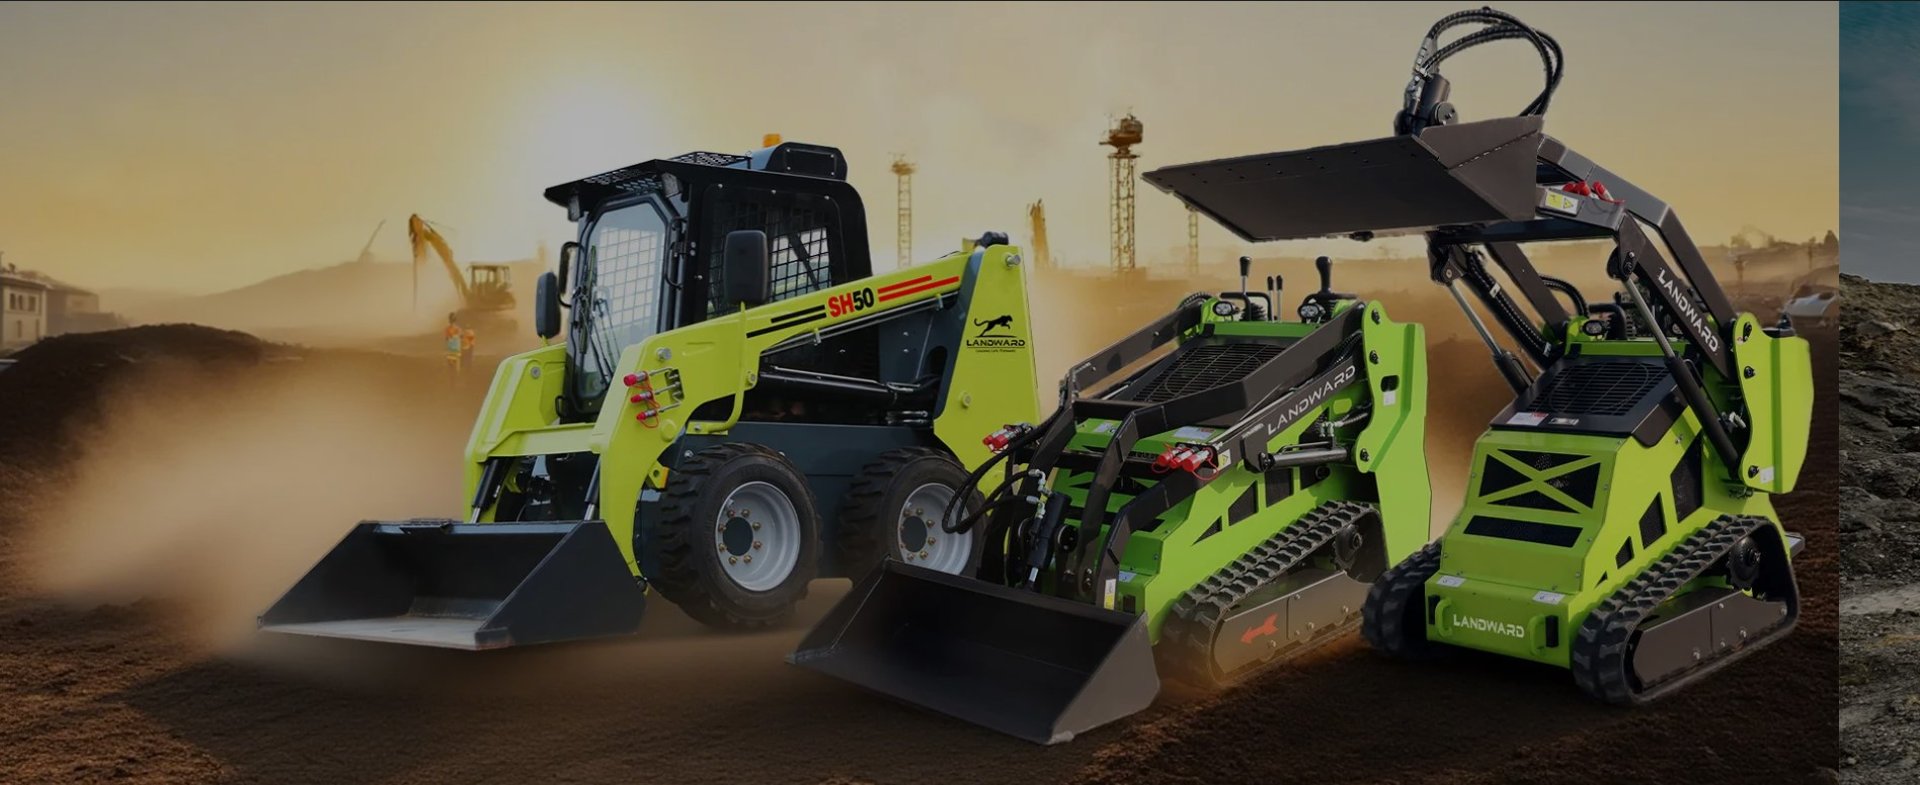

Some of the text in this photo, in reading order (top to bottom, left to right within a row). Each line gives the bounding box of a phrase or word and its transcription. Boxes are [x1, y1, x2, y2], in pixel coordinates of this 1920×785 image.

[828, 287, 874, 317] SH50
[1657, 269, 1718, 352] LANDWARD
[966, 339, 1026, 347] LANDWARD
[1267, 365, 1356, 435] LANDWARD
[1453, 614, 1525, 638] LANDWARD
